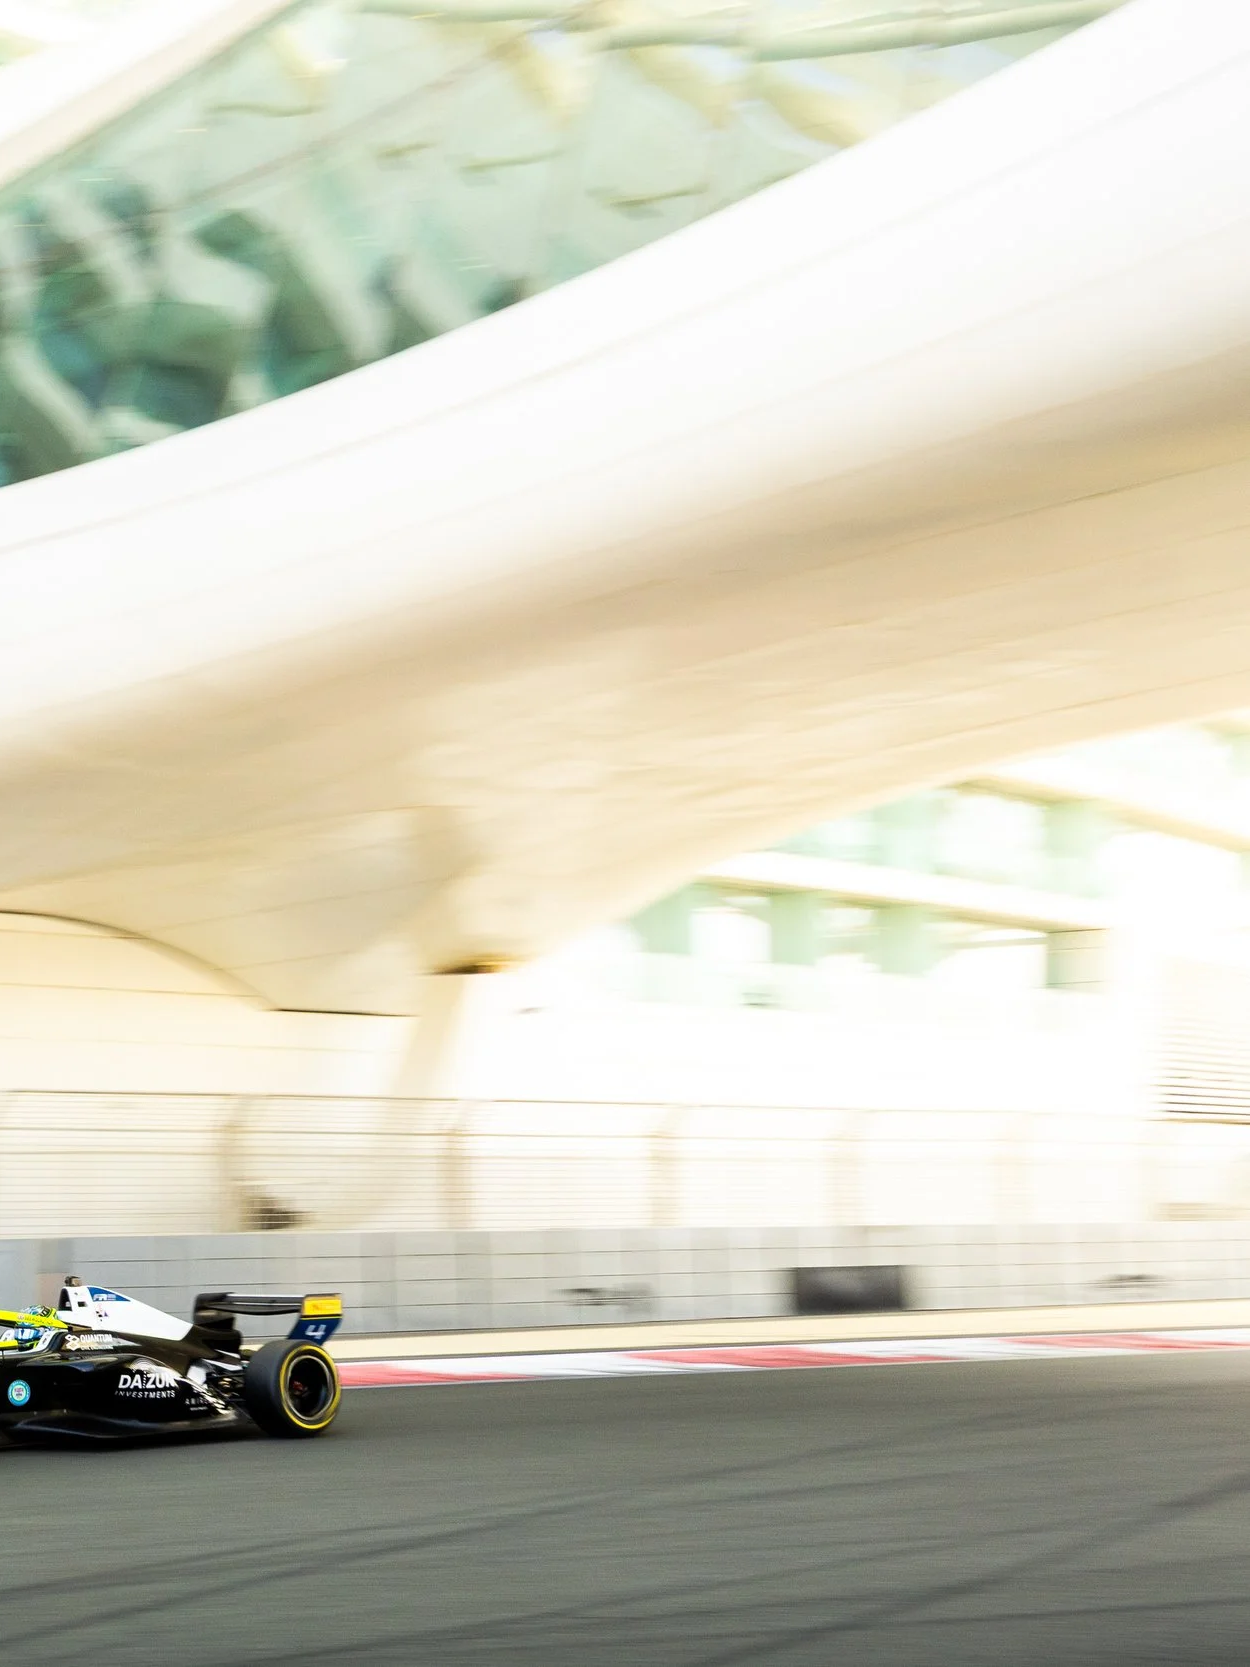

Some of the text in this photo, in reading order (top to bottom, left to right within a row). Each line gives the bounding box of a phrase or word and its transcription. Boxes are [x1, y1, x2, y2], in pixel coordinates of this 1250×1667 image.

[304, 1324, 327, 1340] 4
[80, 1333, 113, 1343] QUANTUM
[114, 1389, 176, 1399] INVESTMENTS
